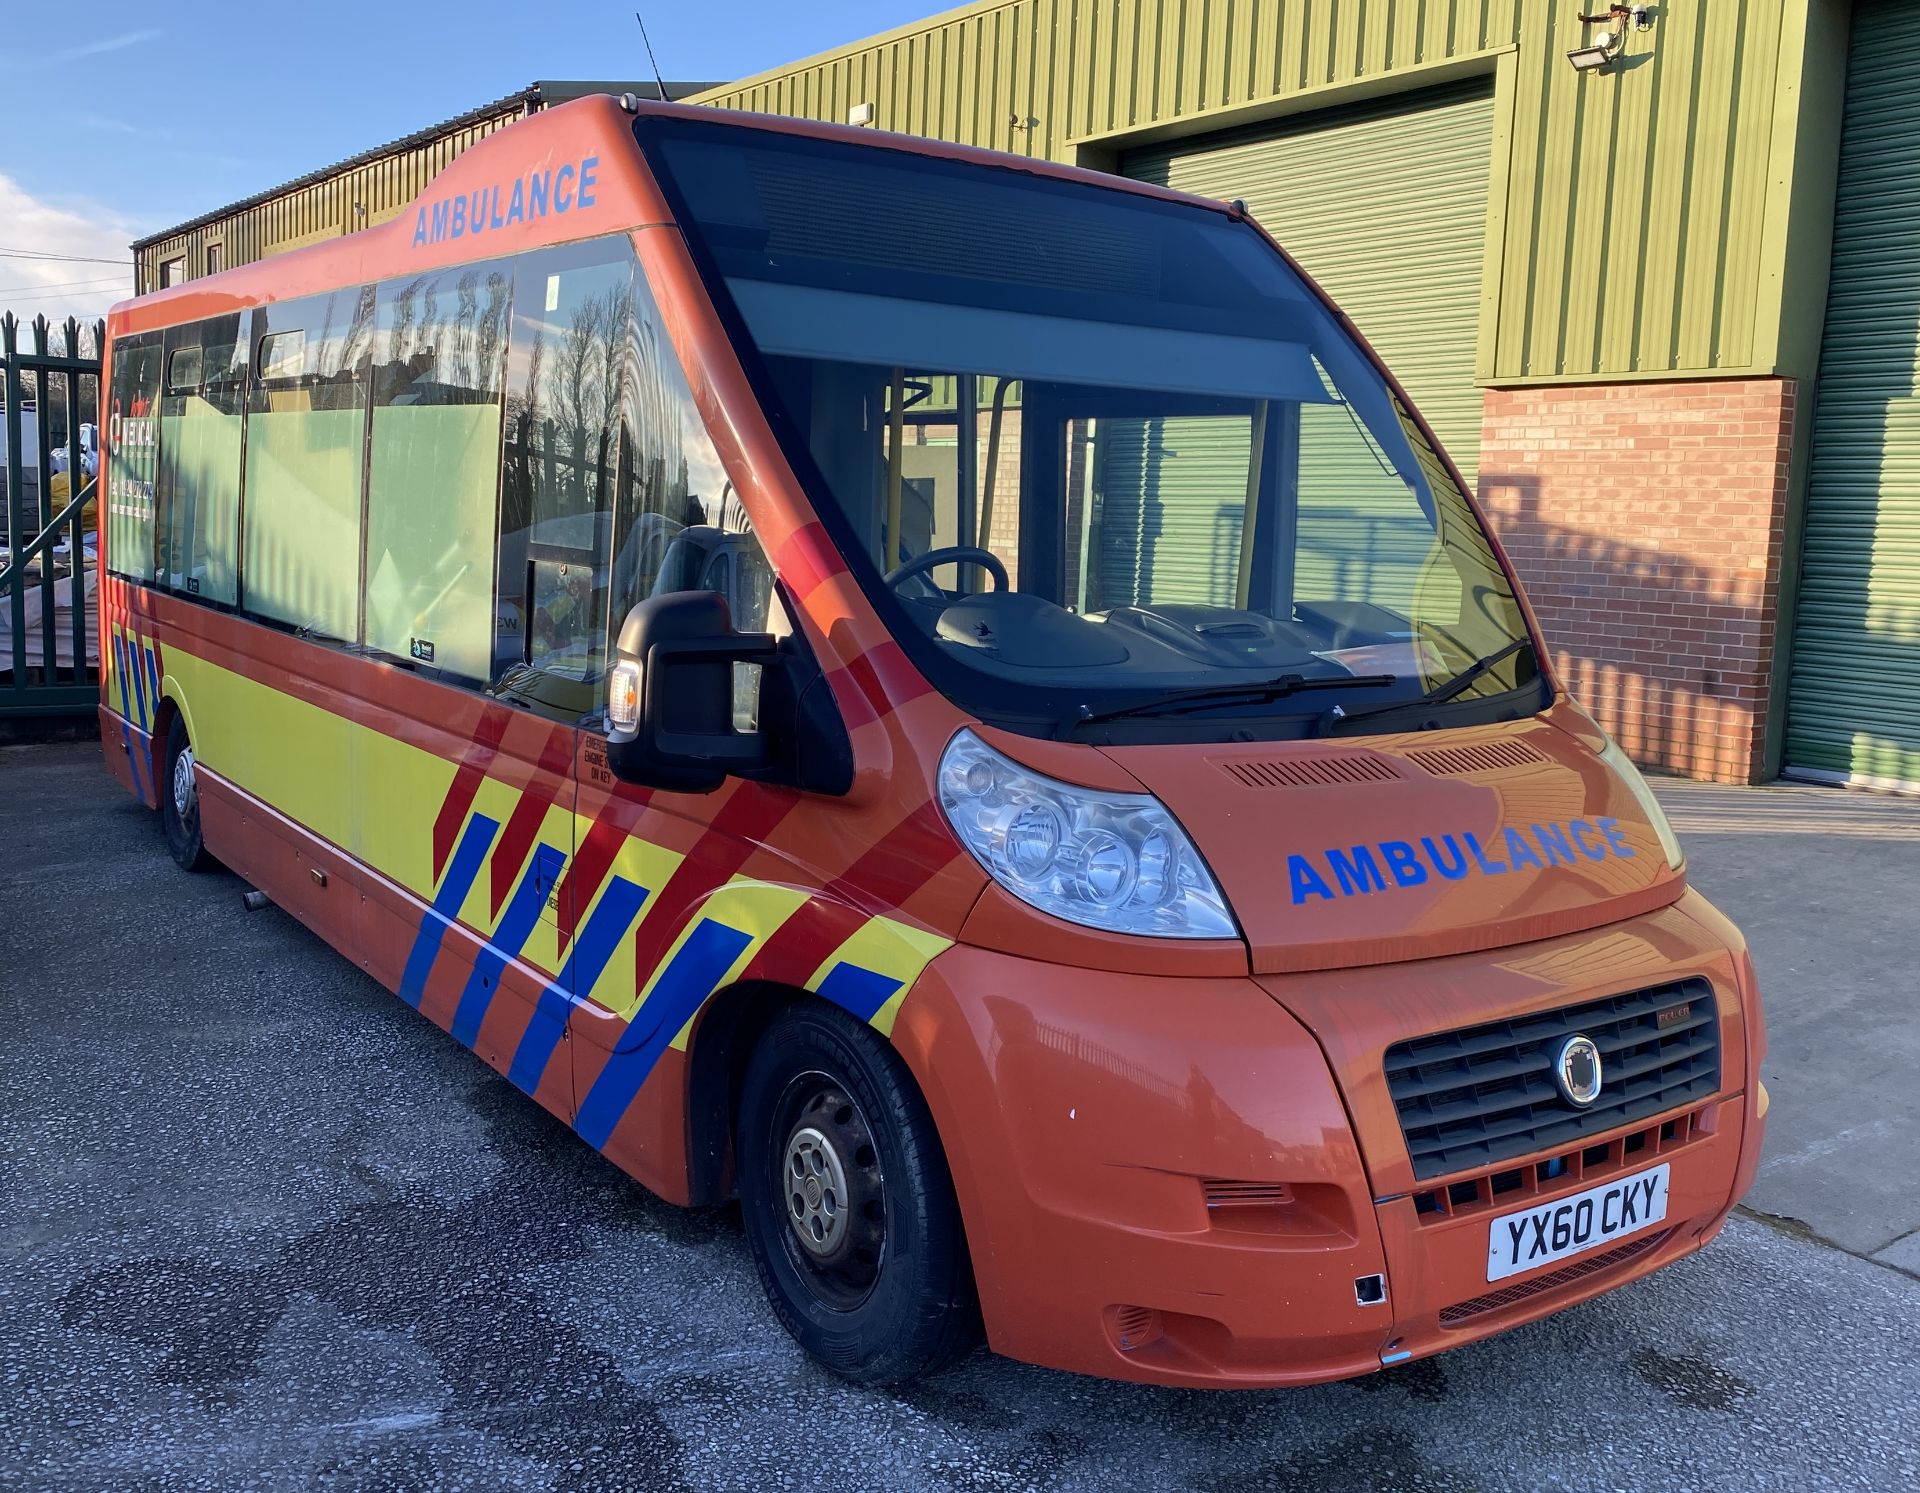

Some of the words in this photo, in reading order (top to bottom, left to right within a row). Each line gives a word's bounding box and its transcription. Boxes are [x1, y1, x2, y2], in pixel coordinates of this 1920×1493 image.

[412, 156, 600, 248] AMBULANCE
[122, 421, 155, 446] MEDICAL
[584, 749, 603, 768] ENGINE
[591, 767, 599, 780] ON
[600, 770, 611, 784] KEY
[1287, 815, 1636, 906] AMBULANCE
[1508, 1198, 1594, 1265] YX60
[1601, 1174, 1659, 1236] CKY
